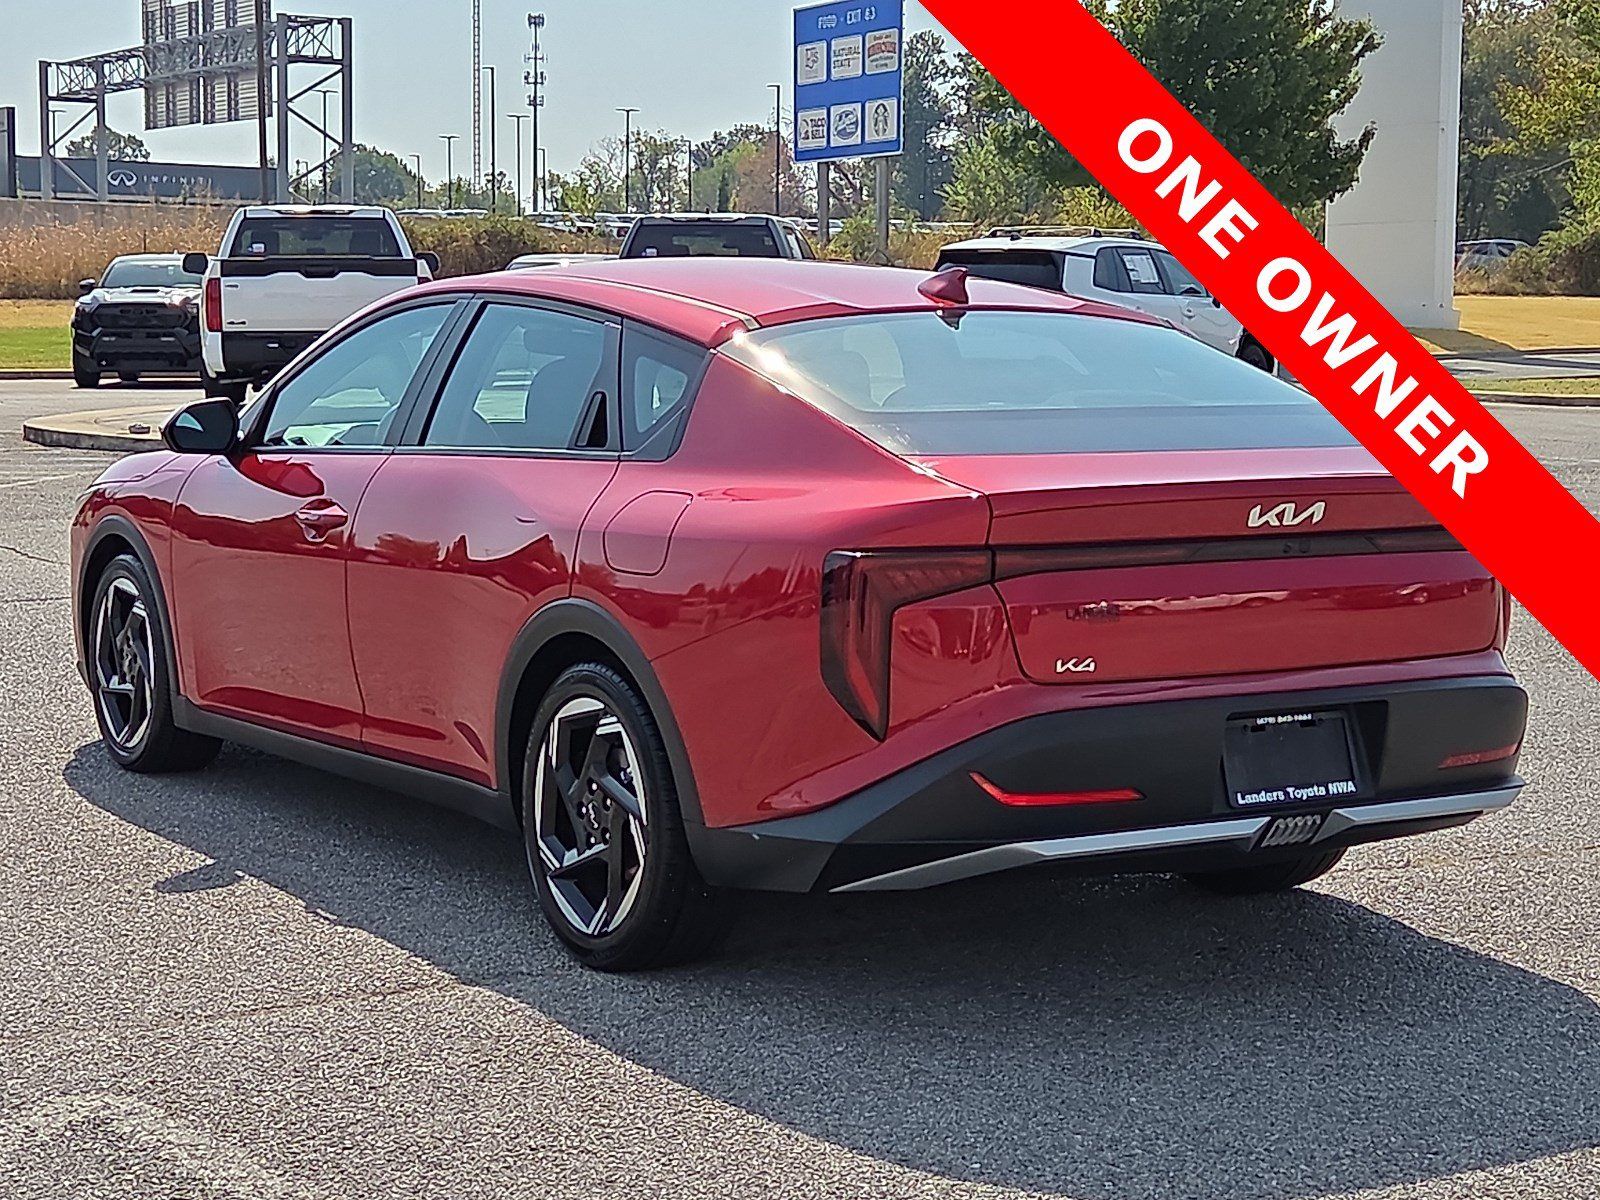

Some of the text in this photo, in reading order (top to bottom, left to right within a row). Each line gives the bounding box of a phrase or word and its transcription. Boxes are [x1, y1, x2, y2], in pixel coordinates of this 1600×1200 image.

[809, 117, 826, 128] TACO
[143, 175, 212, 185] INFINITI
[1247, 501, 1326, 527] KIA
[1055, 656, 1096, 673] K4
[1236, 780, 1357, 805] Landers Toyota NWA
